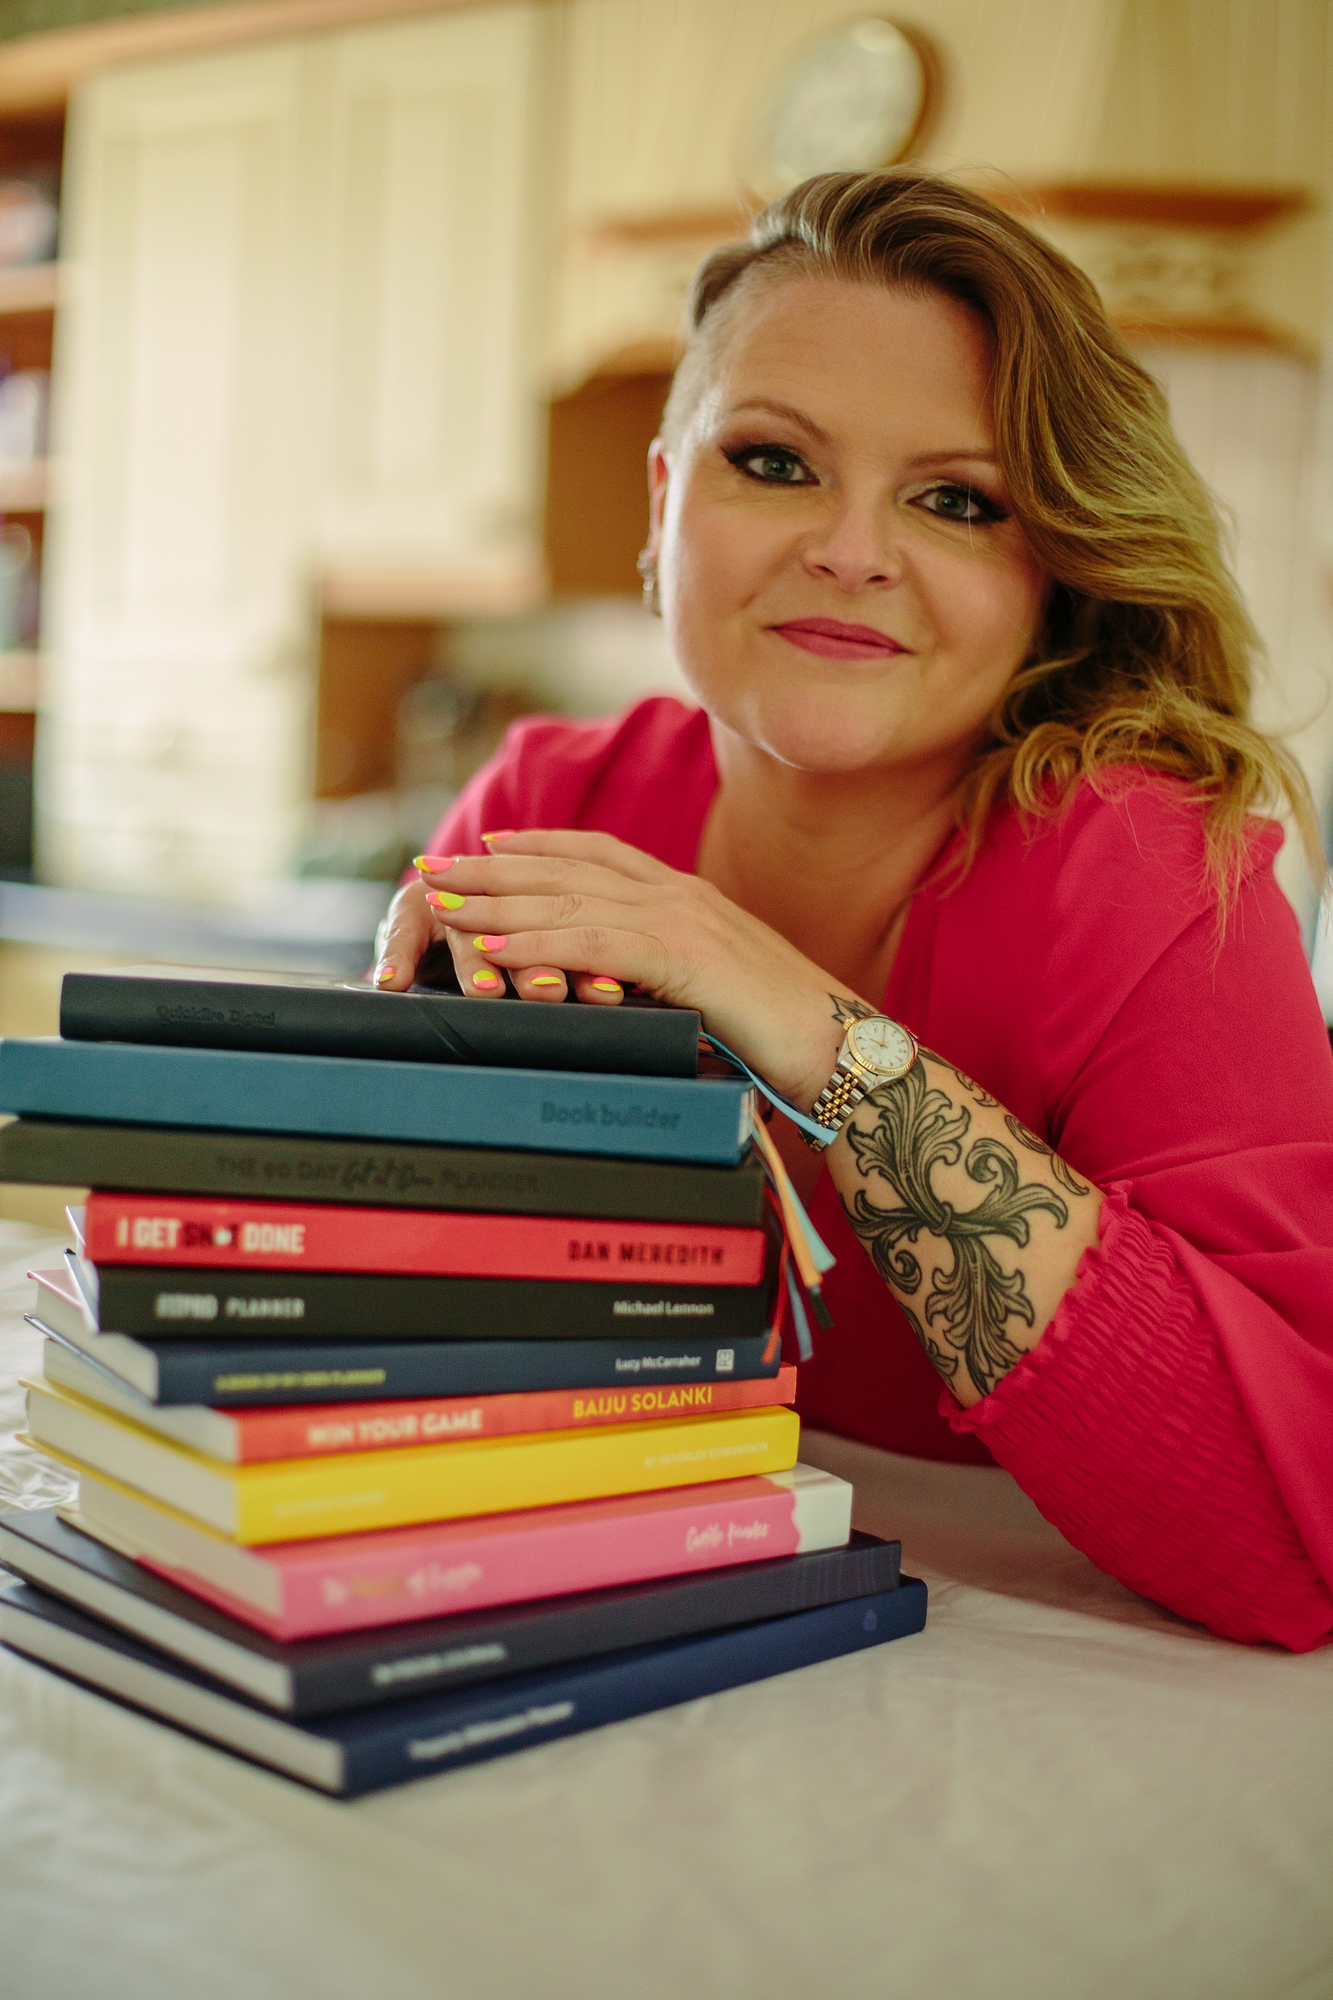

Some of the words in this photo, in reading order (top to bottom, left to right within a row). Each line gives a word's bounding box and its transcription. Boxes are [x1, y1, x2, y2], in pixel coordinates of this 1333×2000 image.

[230, 1009, 276, 1028] Digital
[215, 1155, 257, 1177] THE
[297, 1161, 339, 1180] DAY
[440, 1168, 540, 1193] PLANNER
[117, 1216, 128, 1247] I
[132, 1216, 182, 1248] GET
[183, 1220, 240, 1248] SHT
[243, 1221, 306, 1254] DONE
[568, 1239, 611, 1262] DAN
[619, 1241, 724, 1267] MEREDITH
[225, 1296, 306, 1319] PLANNER
[613, 1300, 665, 1316] Michael
[615, 1357, 641, 1372] Lucy
[572, 1395, 627, 1418] BAIJU
[631, 1385, 713, 1412] SOLANKI
[308, 1423, 354, 1447] WIN
[357, 1414, 419, 1442] YOUR
[421, 1408, 483, 1436] GAME
[709, 1441, 769, 1459] EDMONDSON
